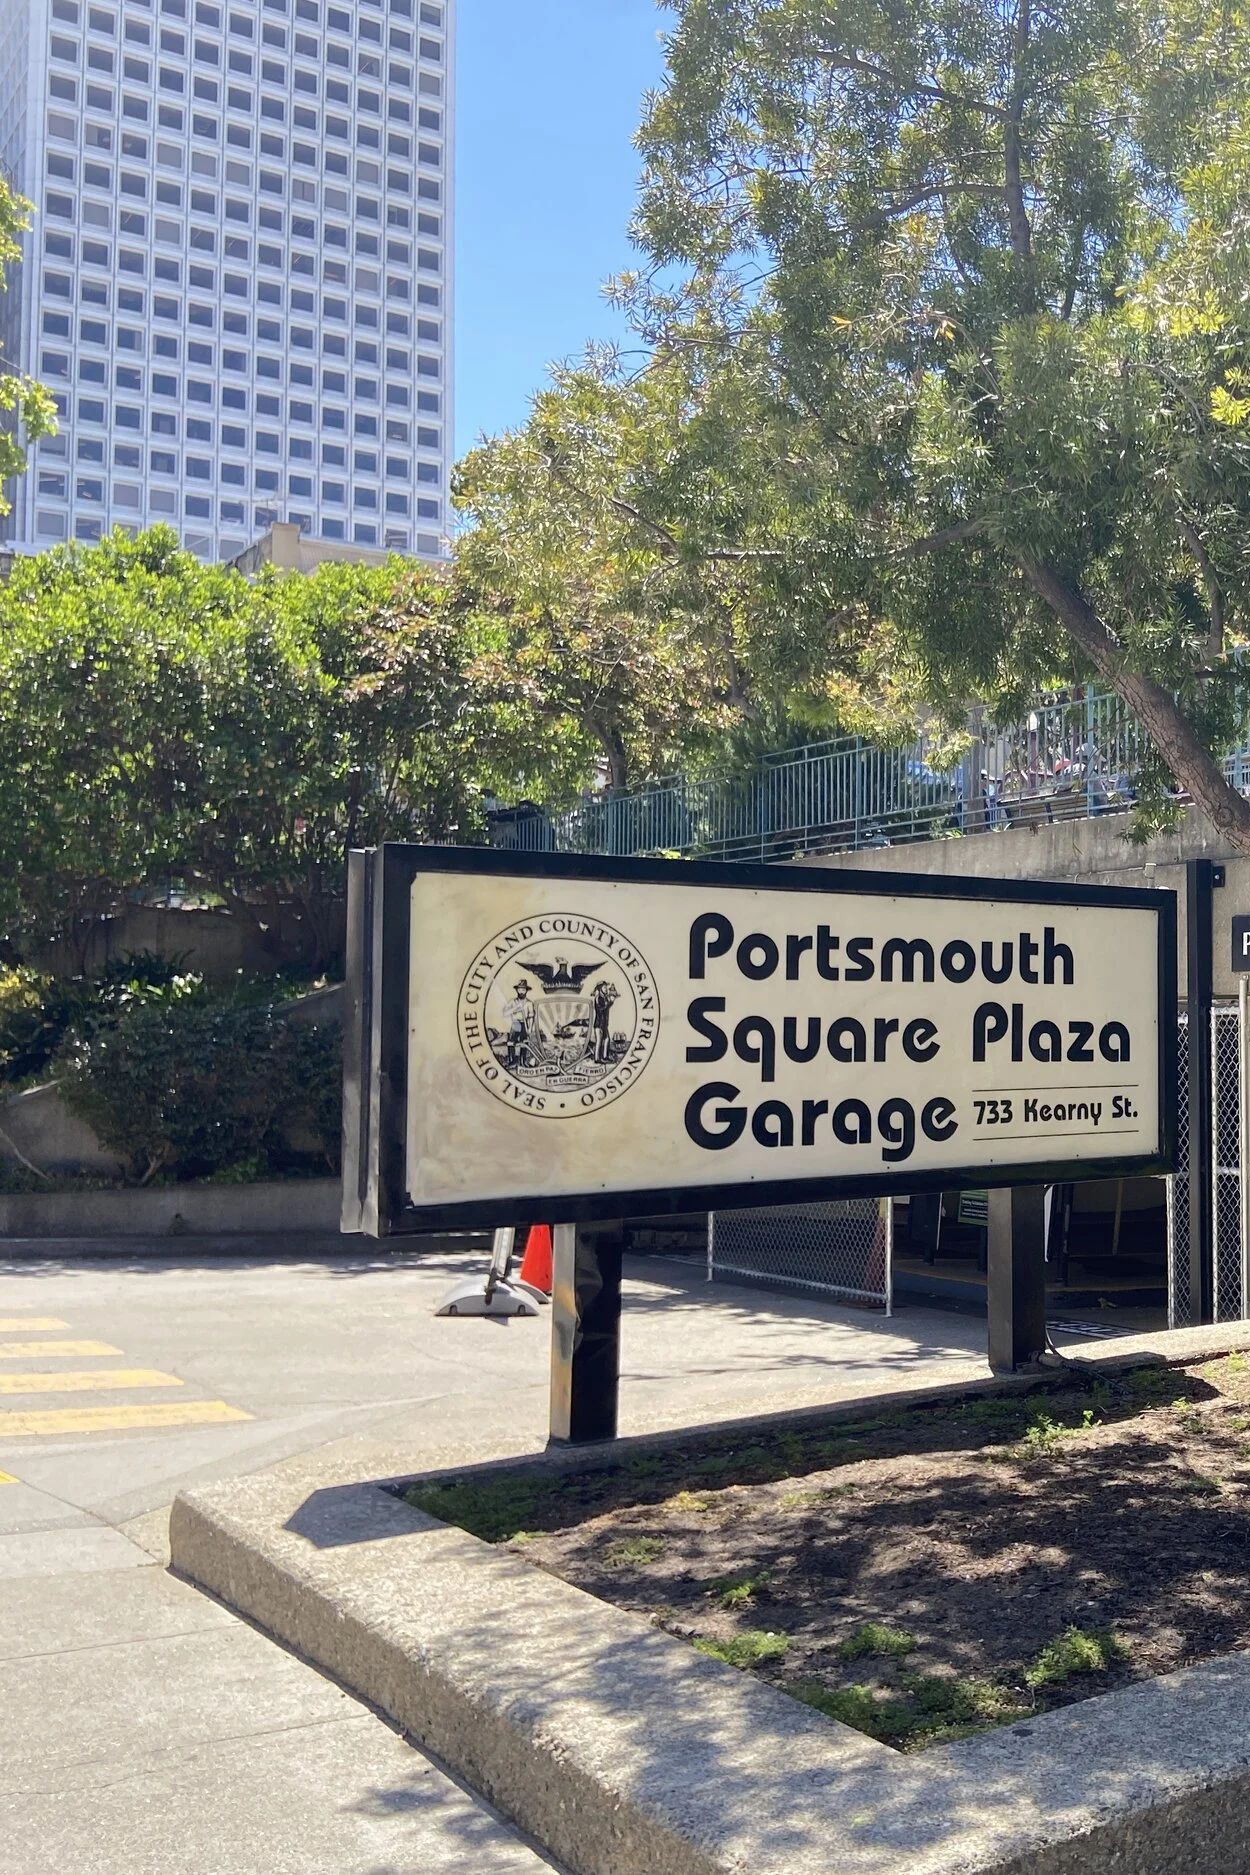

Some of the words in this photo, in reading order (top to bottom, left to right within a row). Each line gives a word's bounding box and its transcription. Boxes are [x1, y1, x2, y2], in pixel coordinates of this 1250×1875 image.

[494, 925, 534, 959] AND
[539, 919, 620, 950] COUNTY
[689, 912, 1075, 986] Portsmouth
[618, 948, 640, 969] OF
[465, 957, 494, 1004] CITY
[634, 972, 654, 1010] SAN
[464, 1011, 483, 1053] THE
[686, 996, 942, 1083] Square
[972, 1001, 1132, 1063] Plaza
[476, 1058, 499, 1081] OF
[581, 1018, 655, 1107] FRANCISCO
[502, 1079, 546, 1111] SEAL
[974, 1100, 1014, 1126] 733
[1024, 1098, 1103, 1127] Kearny
[1112, 1095, 1139, 1120] St.
[685, 1081, 960, 1162] Garage
